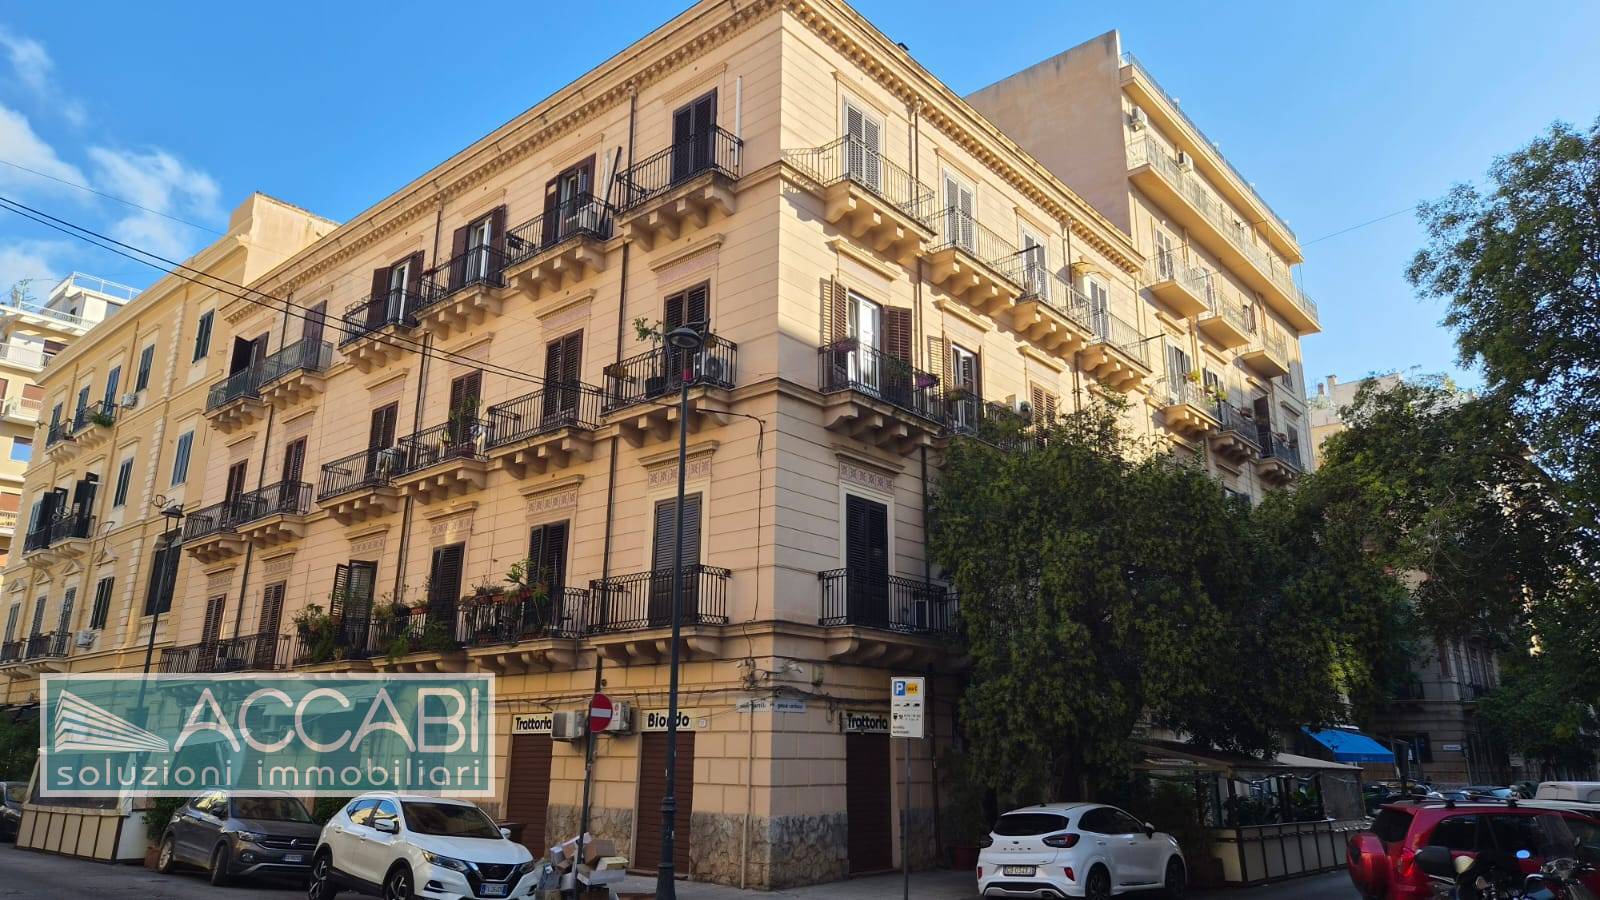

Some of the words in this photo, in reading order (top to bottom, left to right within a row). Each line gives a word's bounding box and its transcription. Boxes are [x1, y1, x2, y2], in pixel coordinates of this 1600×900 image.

[896, 682, 904, 695] P
[515, 715, 552, 730] Trattoria
[647, 711, 689, 728] Biodo
[846, 712, 888, 730] Trattoria
